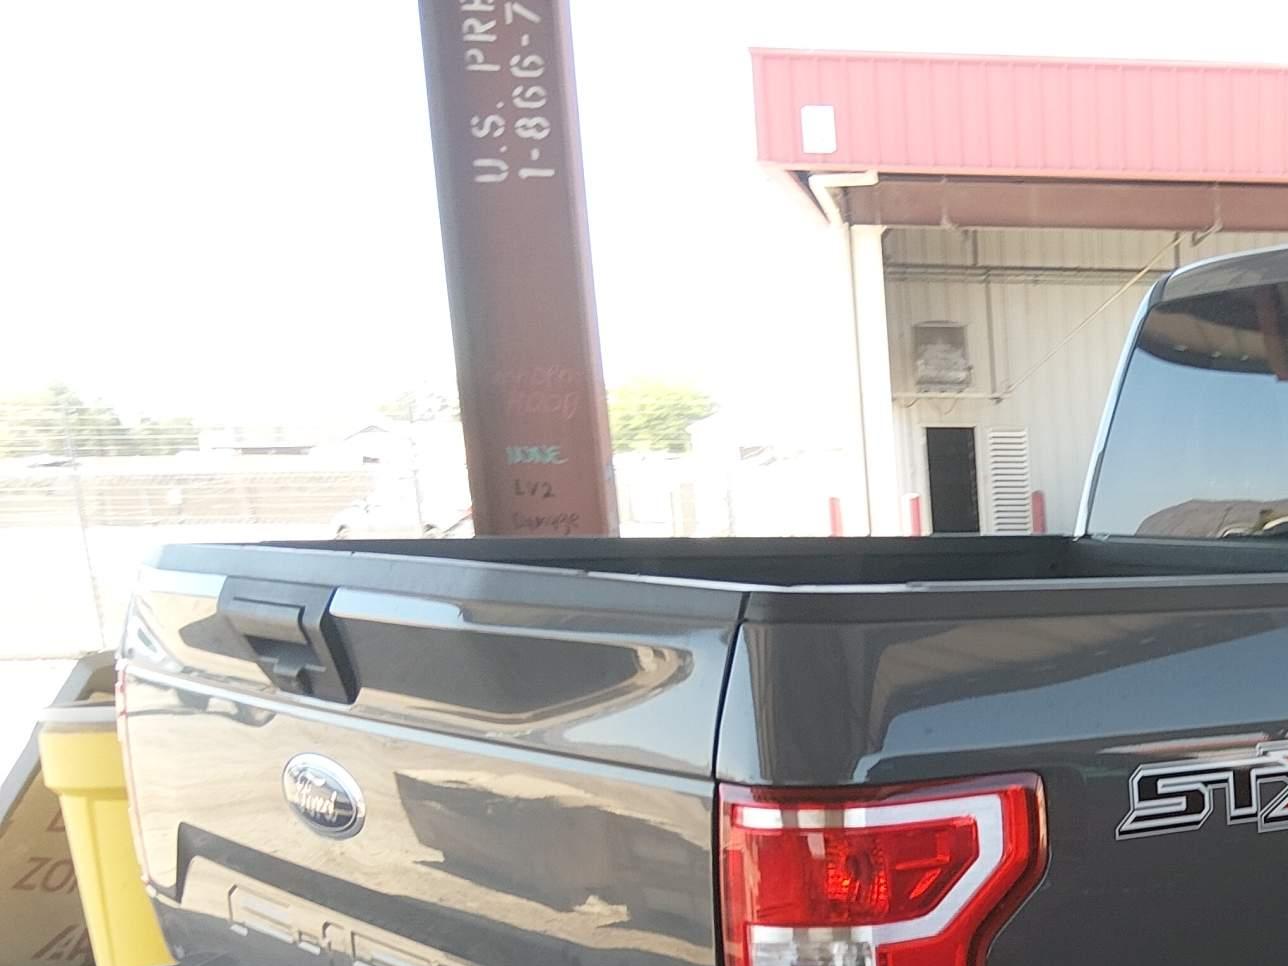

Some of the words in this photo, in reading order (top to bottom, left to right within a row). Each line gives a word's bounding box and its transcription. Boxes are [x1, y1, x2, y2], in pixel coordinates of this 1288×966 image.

[504, 2, 555, 180] 1-866-7
[470, 101, 510, 183] U.S.
[12, 857, 78, 894] ZO
